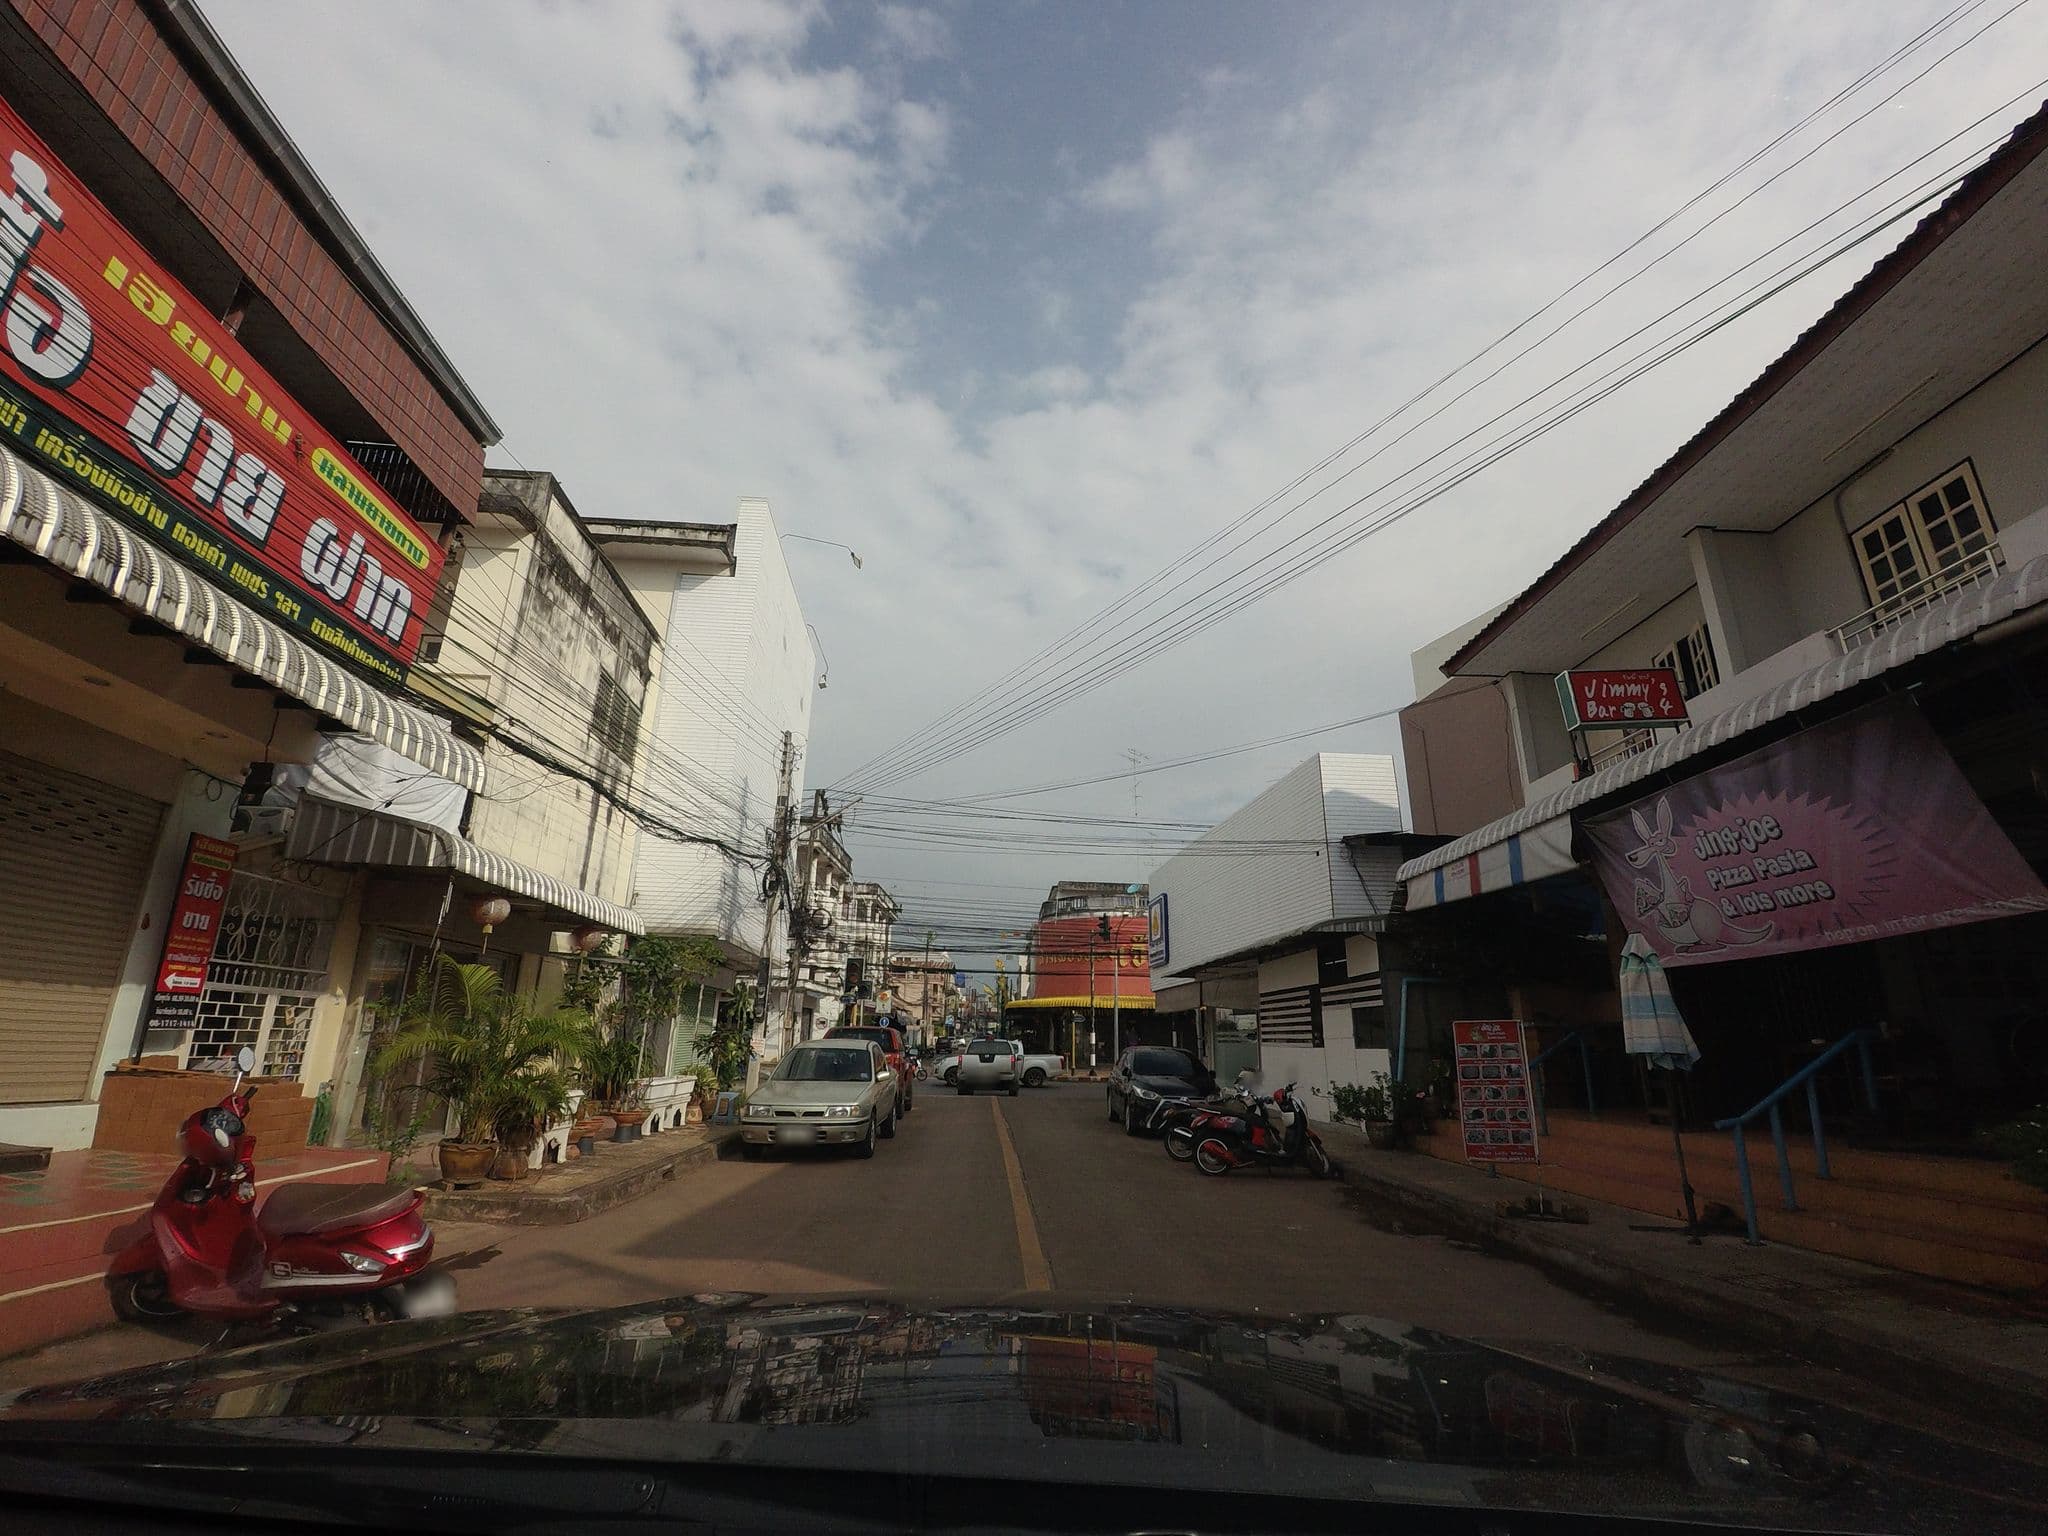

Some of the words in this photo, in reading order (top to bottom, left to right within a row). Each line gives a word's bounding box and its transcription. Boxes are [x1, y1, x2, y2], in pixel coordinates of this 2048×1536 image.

[127, 368, 285, 541] ขาย
[300, 518, 412, 641] ฝาก
[230, 562, 270, 600] เพชร
[1584, 678, 1668, 701] Jimmy's
[1586, 700, 1617, 719] Bar
[1659, 697, 1674, 716] 4
[184, 872, 224, 902] รับซื้อ
[1705, 865, 1757, 891] Pizza
[1753, 849, 1817, 880] Pasta
[1721, 898, 1742, 918] &
[1736, 890, 1776, 914] lots
[1774, 880, 1834, 908] more
[182, 911, 211, 931] ขาย
